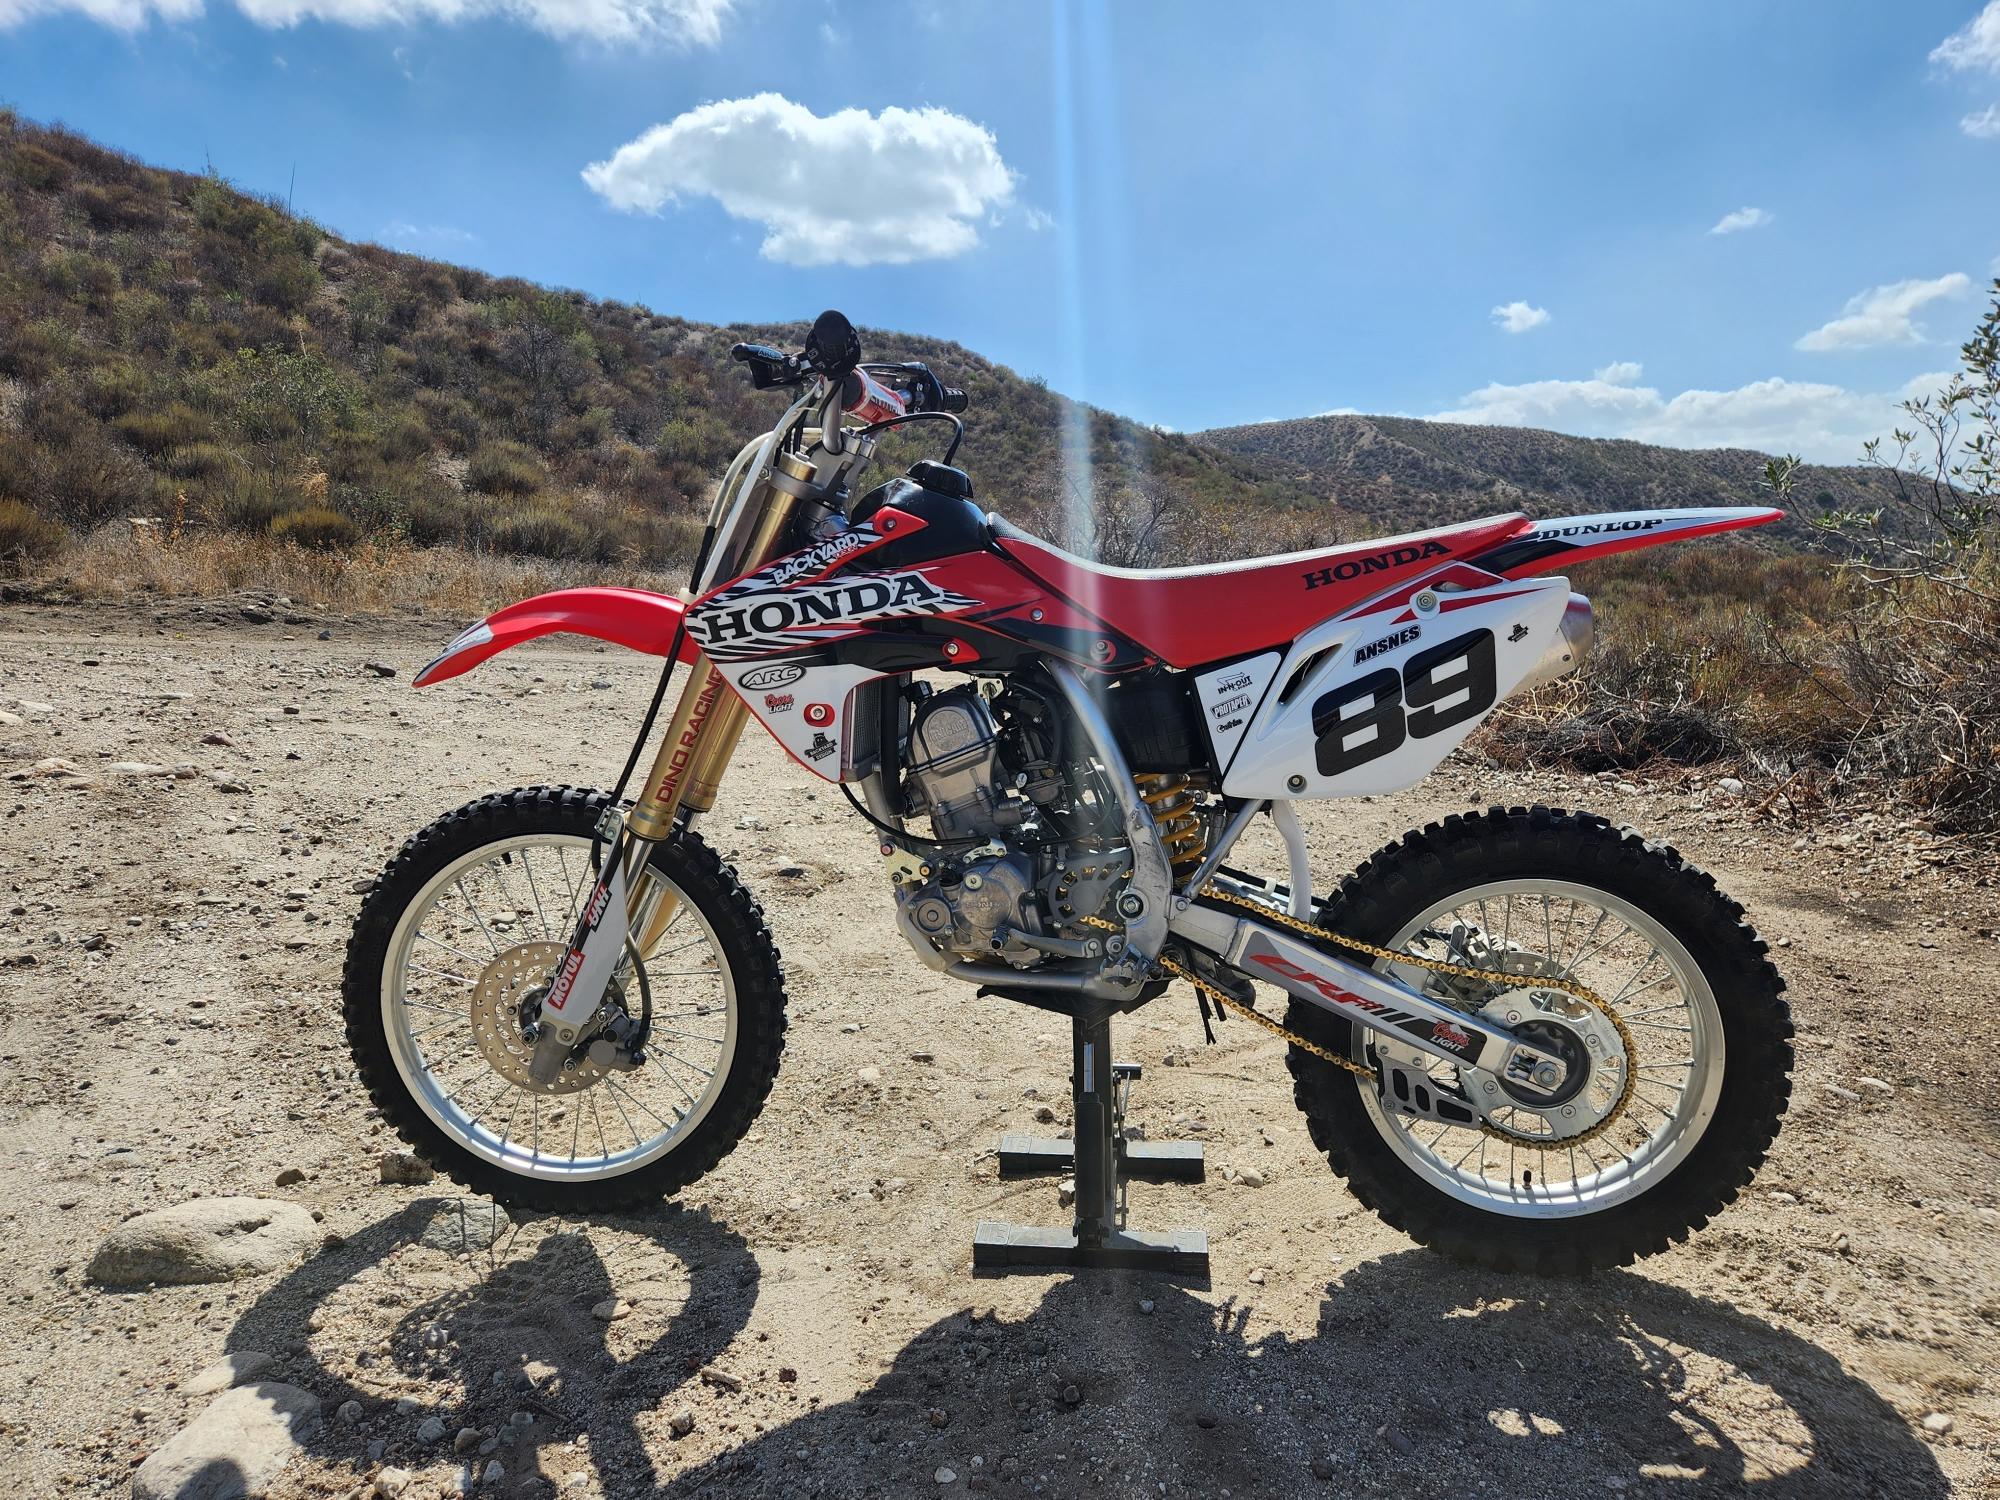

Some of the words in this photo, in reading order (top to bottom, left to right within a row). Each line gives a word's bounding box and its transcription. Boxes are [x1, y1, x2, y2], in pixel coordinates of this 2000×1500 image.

[1540, 519, 1663, 540] DUNLOP
[771, 533, 859, 586] BACKYARD
[1302, 541, 1453, 590] HONDA
[702, 577, 940, 644] HONDA
[1355, 625, 1421, 664] ANSNES
[744, 664, 799, 688] ARC
[769, 703, 793, 714] LIGHT
[1312, 628, 1497, 776] 89
[655, 751, 690, 803] DINO
[680, 667, 723, 748] RACING
[551, 953, 581, 1006] MOTUL
[1429, 1036, 1465, 1052] LIGHT
[1432, 1021, 1472, 1047] Coors
